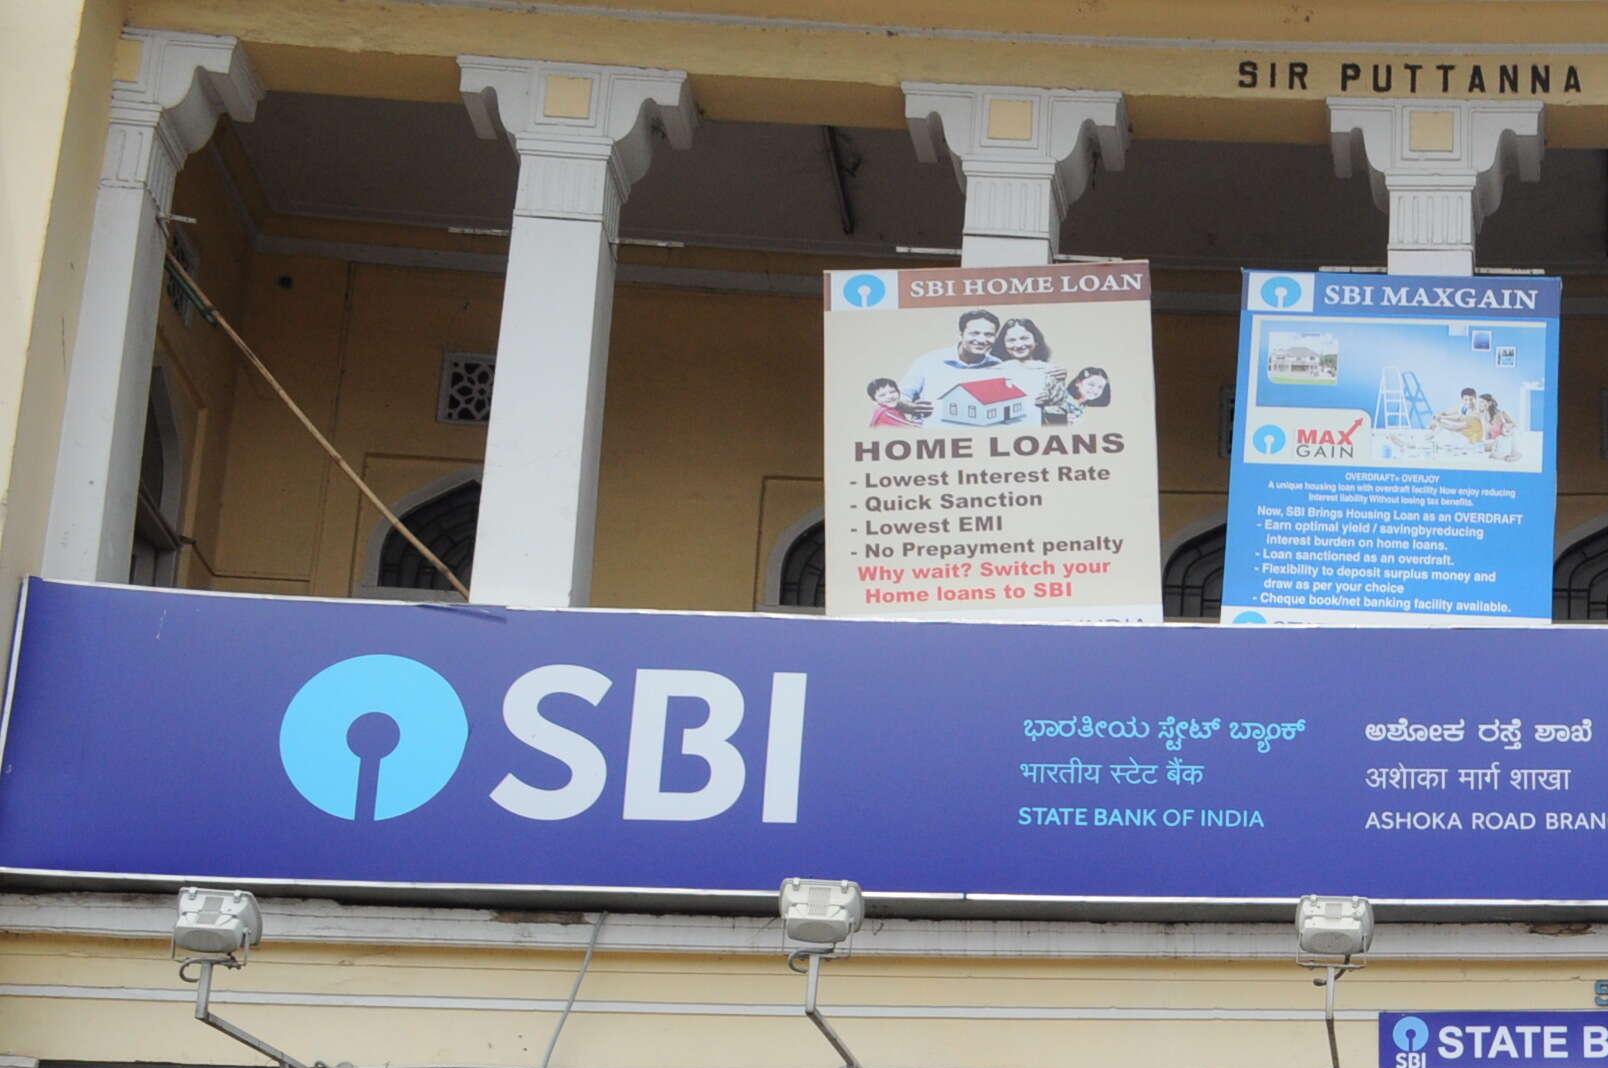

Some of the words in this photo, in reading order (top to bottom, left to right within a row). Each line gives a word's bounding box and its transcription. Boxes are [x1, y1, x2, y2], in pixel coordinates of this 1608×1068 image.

[1237, 61, 1310, 90] SIR
[1340, 64, 1582, 94] PUTTANNA
[910, 280, 955, 297] SBI
[963, 277, 1052, 295] HOME
[1060, 273, 1143, 292] LOAN
[1324, 286, 1380, 306] SBI
[1382, 288, 1538, 309] MAXGAIN
[854, 438, 973, 462] HOME
[990, 432, 1125, 457] LOANS
[1297, 429, 1353, 446] MAX
[1296, 445, 1354, 459] GAIN
[865, 471, 948, 488] Lowest
[958, 469, 1049, 485] Interest
[1058, 466, 1110, 482] Rate
[865, 494, 932, 512] Quick
[940, 492, 1042, 509] Sanction
[865, 519, 950, 535] Lowest
[959, 516, 1002, 532] EMI
[1286, 506, 1304, 517] SBI
[1308, 507, 1343, 520] Brings
[1346, 508, 1390, 522] Housing
[1394, 510, 1419, 520] Loan
[1423, 512, 1435, 521] as
[1439, 513, 1451, 521] an
[1454, 512, 1523, 525] OVERDRAFT
[865, 543, 894, 559] No
[902, 539, 1034, 559] Prepayment
[1043, 536, 1123, 554] penalty
[858, 565, 903, 583] Why
[912, 563, 972, 579] wait?
[980, 561, 1055, 577] Switch
[1063, 559, 1111, 577] your
[865, 587, 929, 604] Home
[938, 585, 996, 601] loans
[1004, 585, 1025, 599] to
[1034, 582, 1072, 598] SBI
[489, 664, 808, 823] SBI
[1024, 716, 1149, 742] ಭಾರತೀಯ
[1158, 716, 1221, 750] ಸ್ಟೇಟ್
[1229, 719, 1306, 753] ಬ್ಯಾಂಕ್
[1365, 717, 1465, 742] ಅಶೋಕ
[1478, 719, 1522, 750] ರಸ್ತೆ
[1535, 718, 1592, 743] ಶಾಖೆ
[1020, 757, 1102, 784] भारतीय
[1110, 757, 1158, 784] स्टेट
[1166, 758, 1204, 784] बैंक
[1458, 762, 1500, 790] मार्ग
[1510, 769, 1571, 790] शाखा
[1018, 808, 1088, 825] STATE
[1094, 808, 1156, 826] BANK
[1163, 809, 1194, 826] OF
[1201, 810, 1264, 827] INDIA
[1365, 812, 1462, 829] ASHOKA
[1472, 812, 1536, 829] ROAD
[1438, 1026, 1568, 1059] STATE
